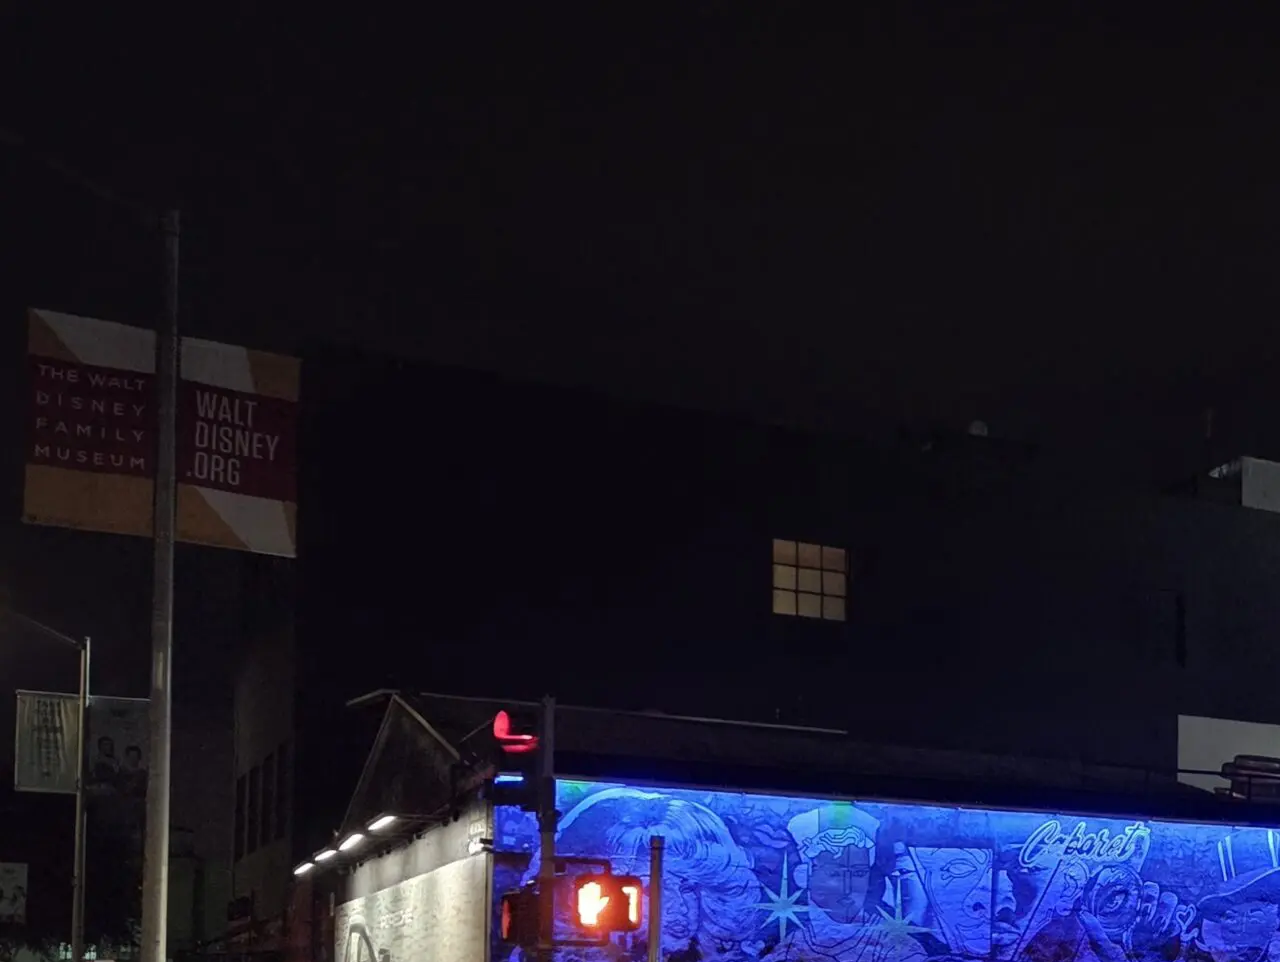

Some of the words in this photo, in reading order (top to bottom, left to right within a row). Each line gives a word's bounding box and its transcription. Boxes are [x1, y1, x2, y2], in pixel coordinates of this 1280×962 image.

[37, 364, 78, 382] THE
[89, 372, 145, 392] WALT
[36, 390, 146, 417] DISNEY
[196, 390, 257, 428] WALT
[35, 418, 145, 443] FAMILY
[195, 421, 280, 461] DISNEY
[34, 445, 145, 470] MUSEUM
[186, 452, 241, 486] .ORG
[1019, 820, 1151, 868] Cabaret
[622, 886, 638, 924] 7
